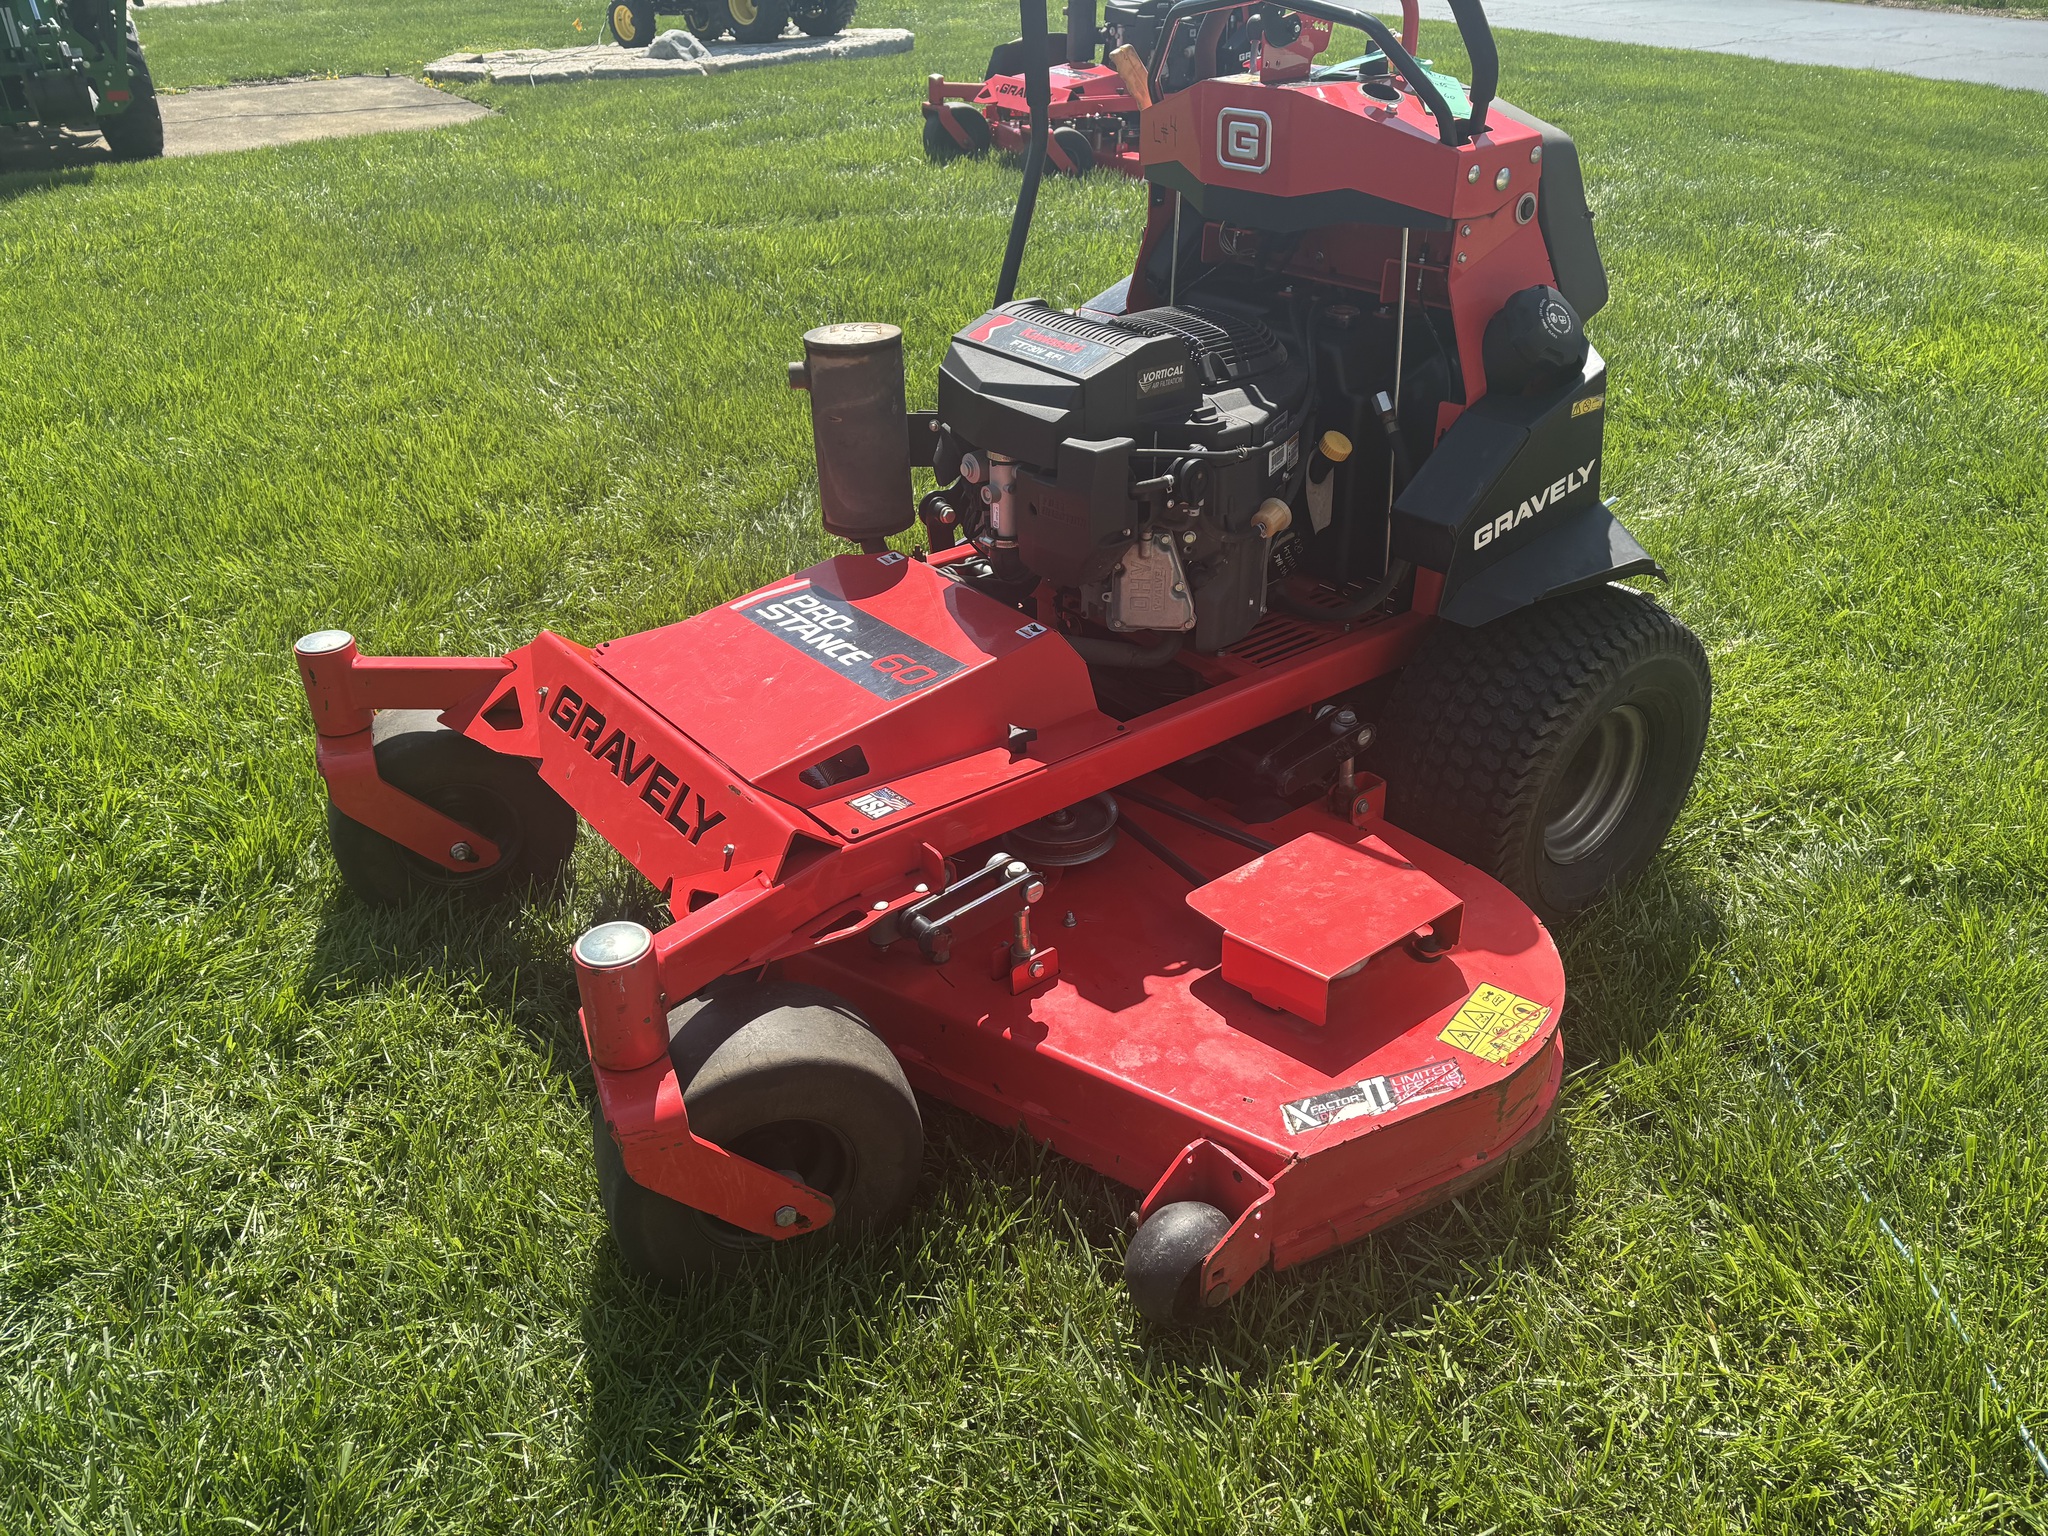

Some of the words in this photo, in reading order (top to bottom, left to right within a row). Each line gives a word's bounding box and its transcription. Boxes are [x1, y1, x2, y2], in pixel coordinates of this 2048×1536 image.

[1142, 364, 1184, 384] VORTICAL
[1160, 376, 1184, 388] FILTRATION
[1473, 458, 1597, 552] GRAVELY
[1130, 560, 1153, 611] OHV
[783, 594, 855, 633] PRO-
[755, 603, 874, 667] STANCE
[870, 653, 940, 686] 60
[548, 684, 728, 848] GRAVELY
[851, 793, 895, 819] USA
[1287, 1098, 1322, 1130] X
[1310, 1094, 1360, 1115] FACTOR
